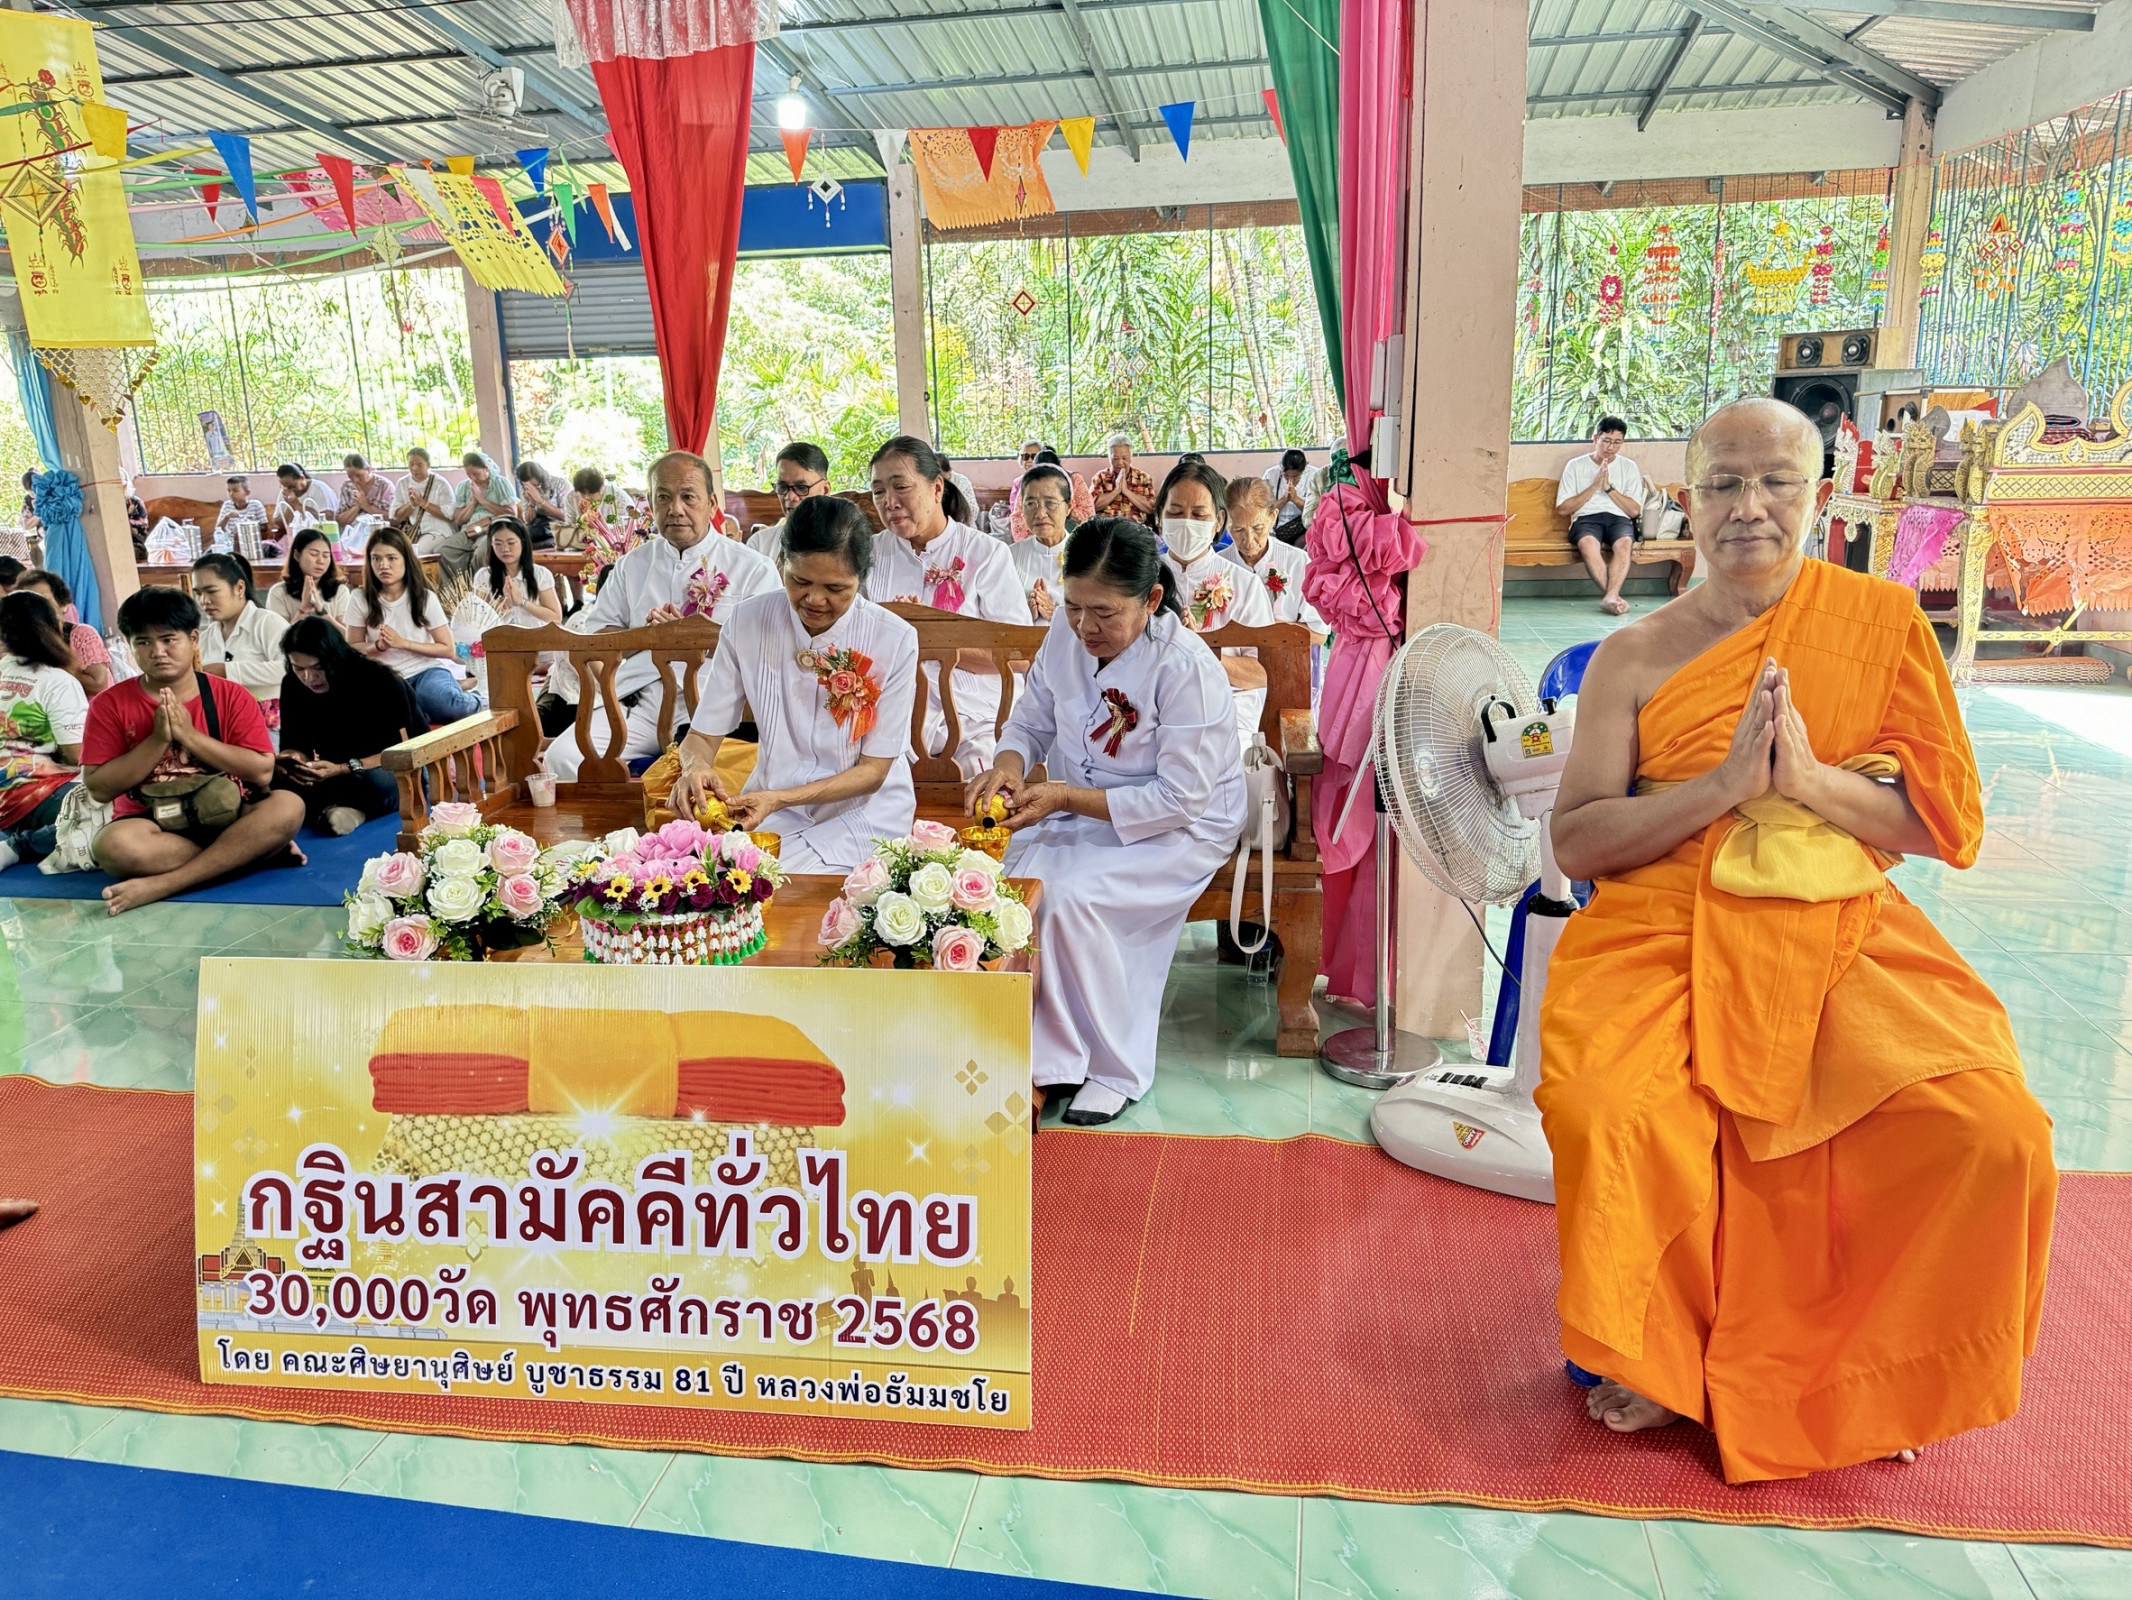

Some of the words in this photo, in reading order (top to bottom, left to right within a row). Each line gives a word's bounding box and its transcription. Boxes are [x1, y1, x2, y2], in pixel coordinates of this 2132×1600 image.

[249, 1137, 971, 1261] กฐินสามัคคีทั่วไทย
[248, 1268, 497, 1328] 30,000วัด
[518, 1277, 814, 1348] พุทธศักราช
[837, 1298, 976, 1350] 2568
[217, 1339, 270, 1371] โดย
[283, 1350, 515, 1389] คณะศิษยานุศิษย์
[526, 1363, 661, 1393] บูชาธรรม
[676, 1369, 710, 1394] 81
[723, 1364, 744, 1395] ปี
[757, 1373, 1008, 1413] หลวงพ่อธัมมชโย
